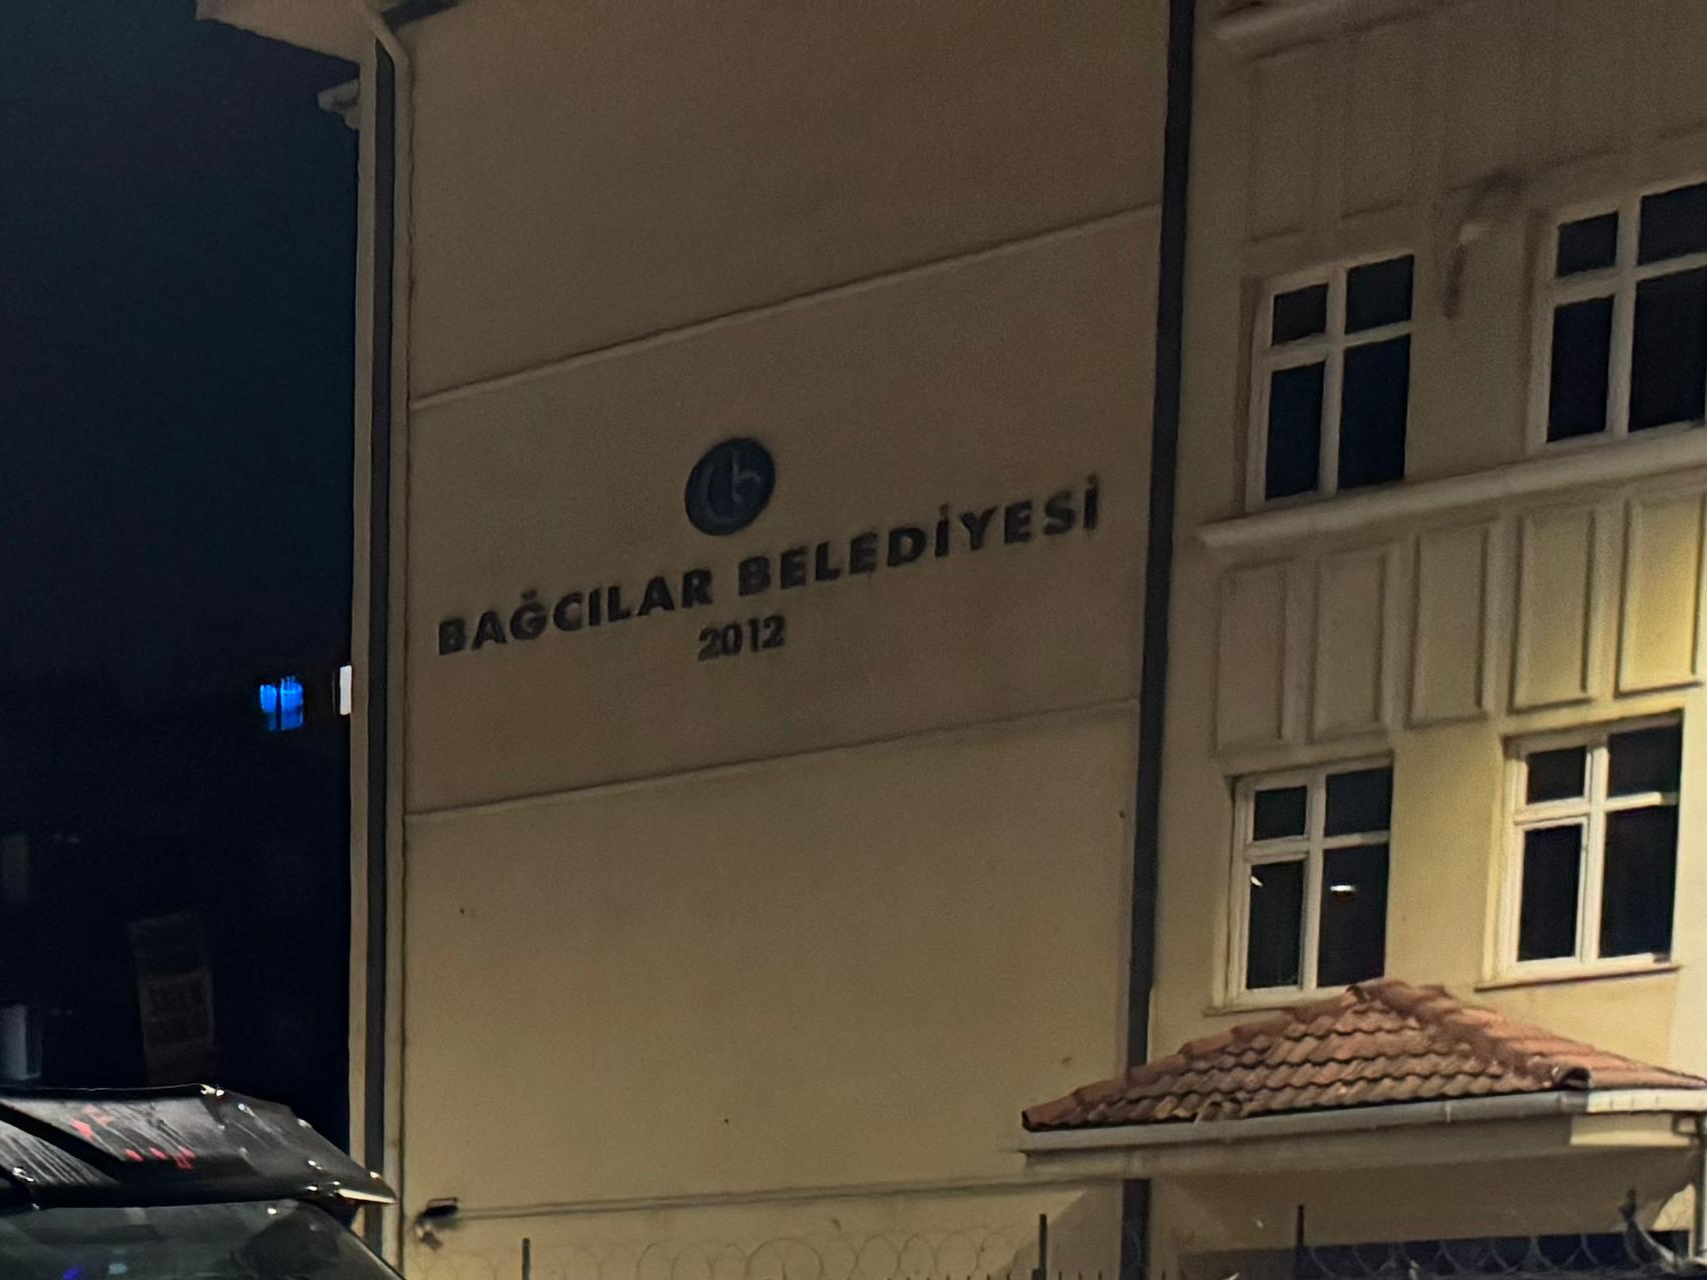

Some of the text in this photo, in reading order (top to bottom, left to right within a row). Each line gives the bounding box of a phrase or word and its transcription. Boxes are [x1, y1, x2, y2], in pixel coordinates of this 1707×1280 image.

[437, 472, 1101, 657] BAĞCILAR BELEDİYESİ
[697, 613, 787, 662] 2012
